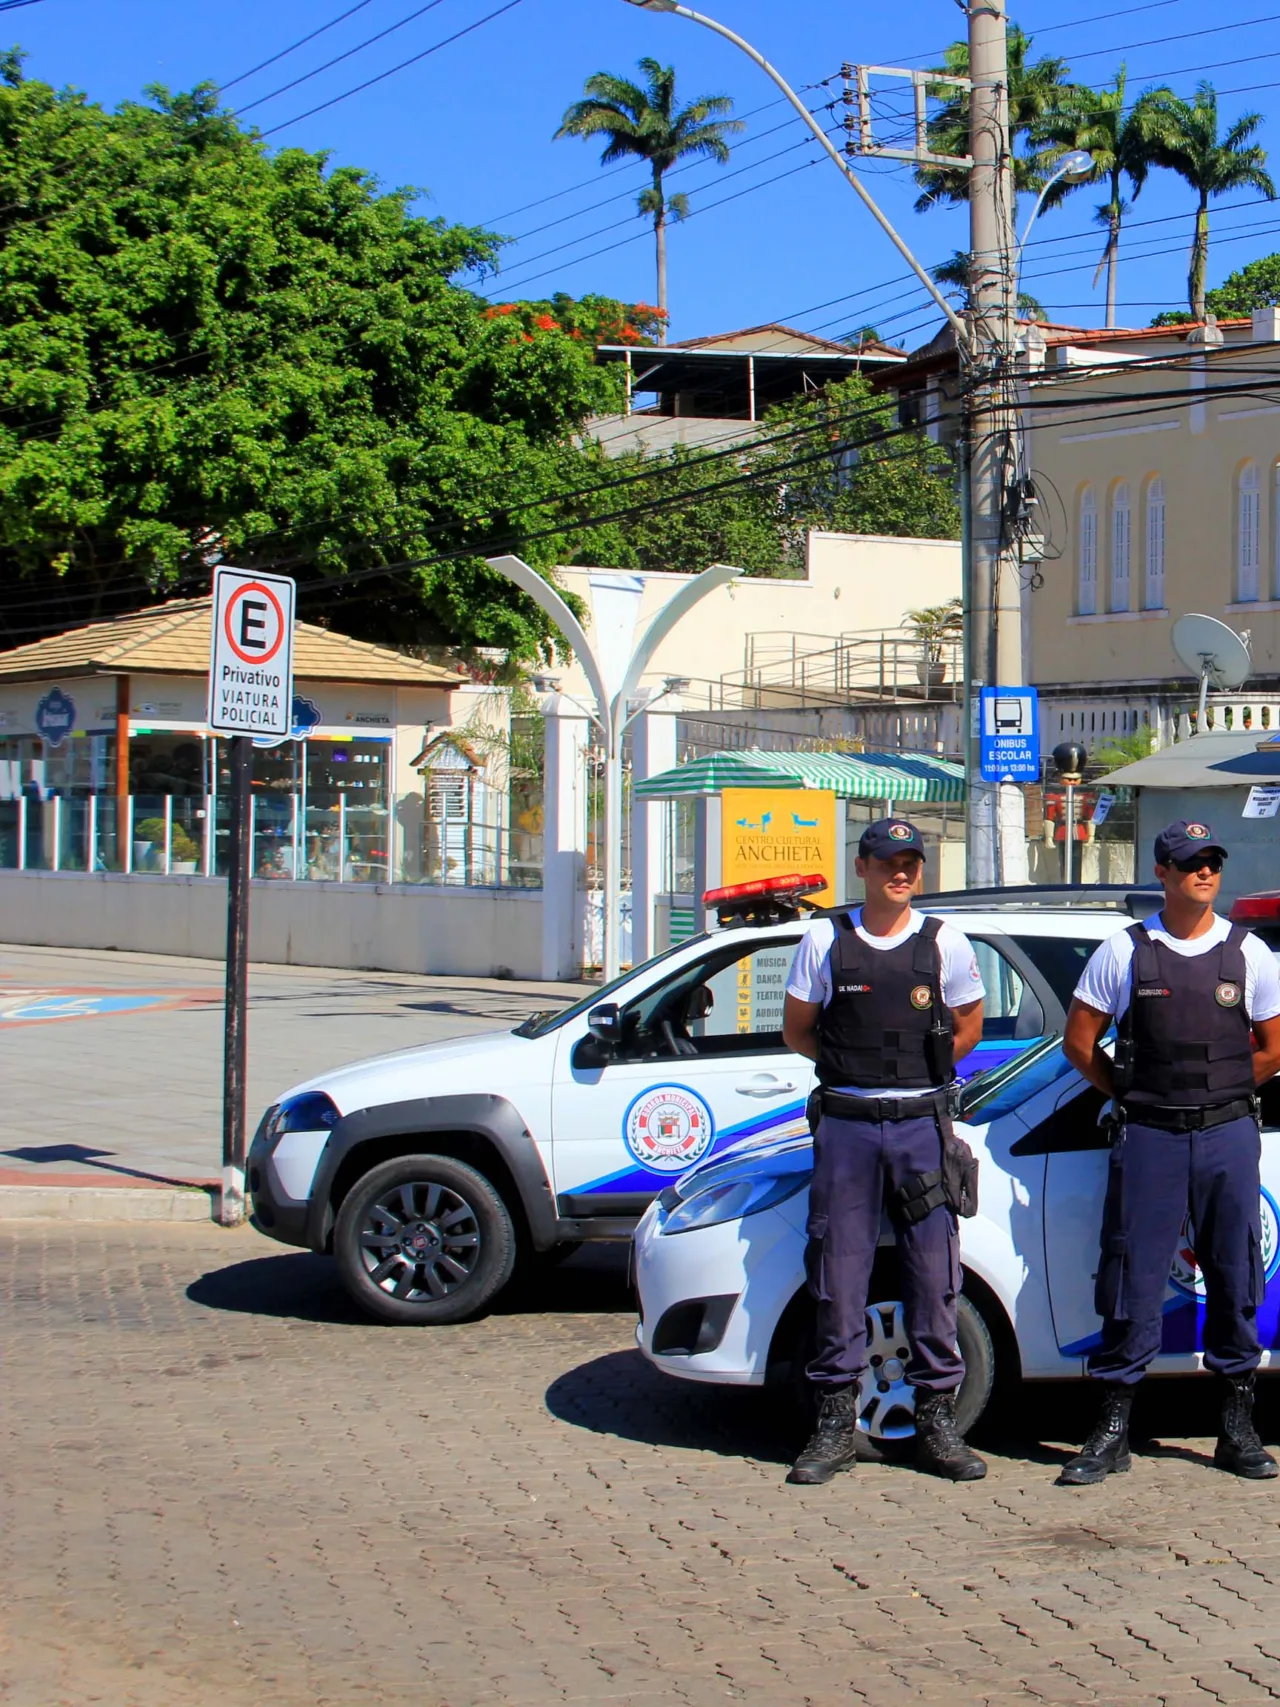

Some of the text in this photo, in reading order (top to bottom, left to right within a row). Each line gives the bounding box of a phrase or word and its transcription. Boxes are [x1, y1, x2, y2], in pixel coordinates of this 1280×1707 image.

[240, 599, 268, 650] E
[222, 665, 280, 688] Privativo
[221, 688, 279, 709] VIATURA
[221, 707, 278, 726] POLICIAL
[988, 750, 1032, 761] ESCOLAR
[1027, 763, 1035, 772] hs
[735, 835, 821, 845] CENTRO CULTURAL
[734, 845, 823, 862] ANCHIETA
[756, 956, 787, 968] MÚSICA
[756, 974, 783, 986] DANÇA
[756, 991, 784, 1001] TEATRO
